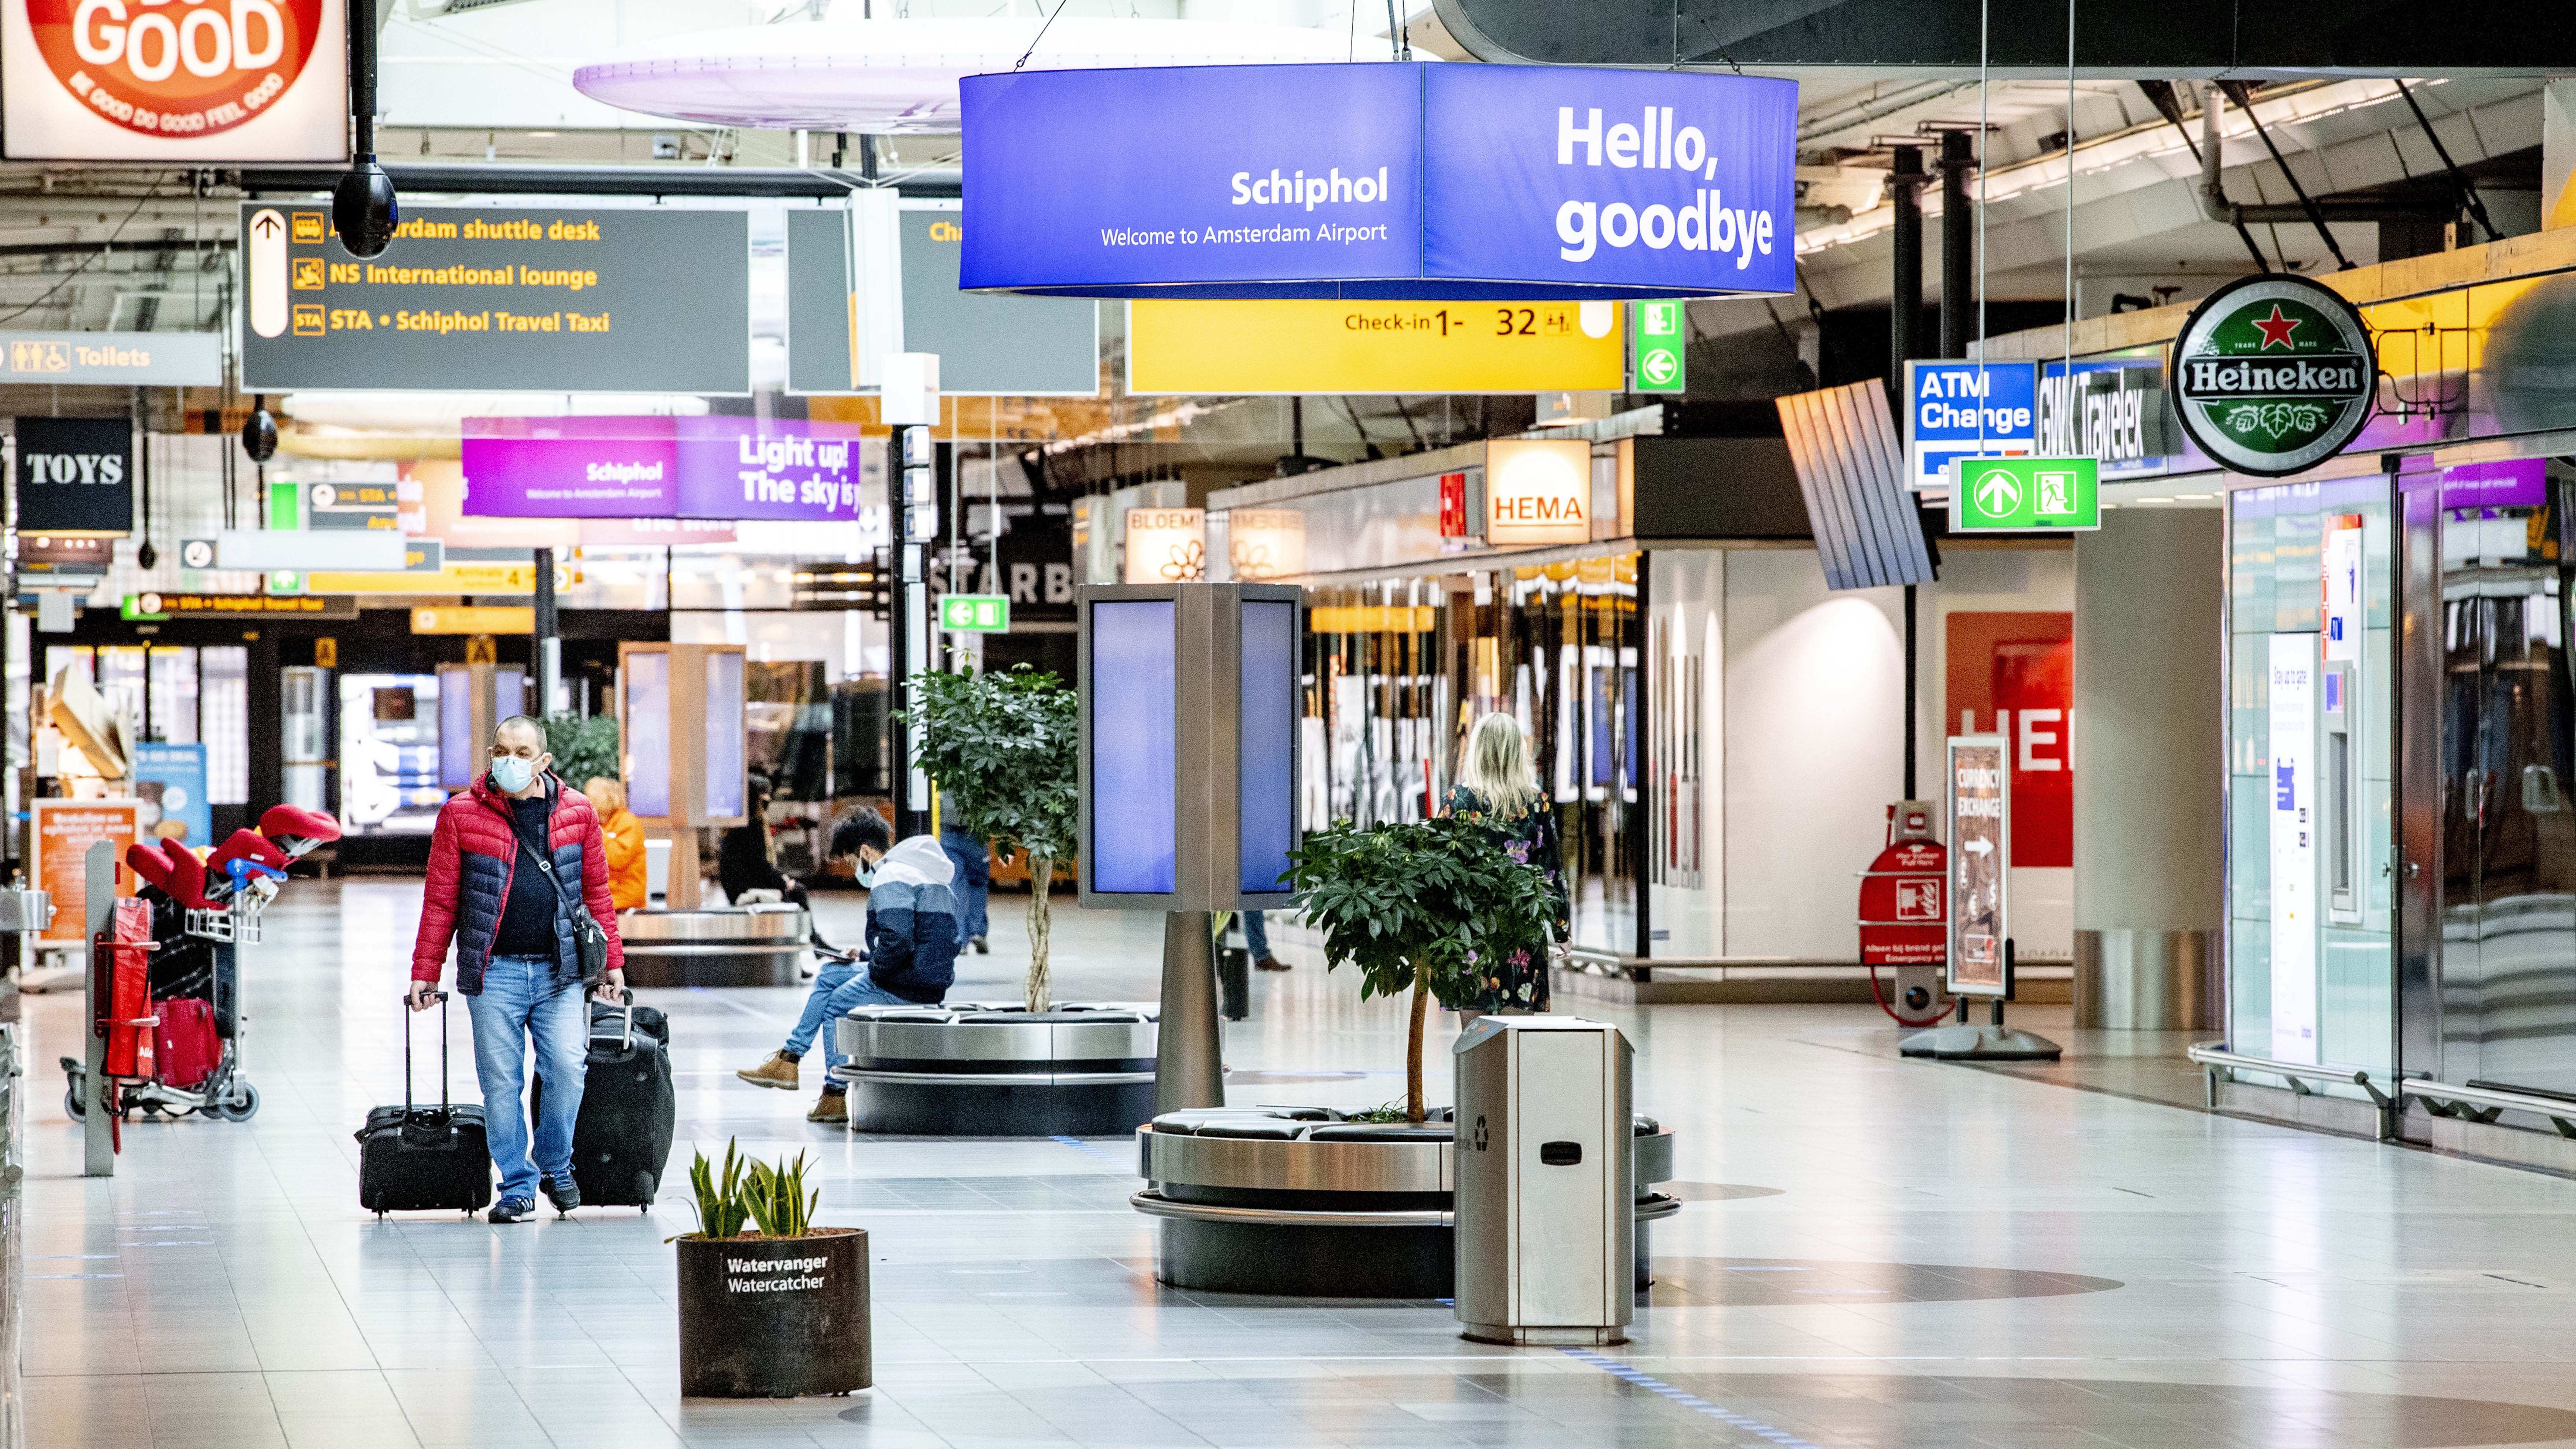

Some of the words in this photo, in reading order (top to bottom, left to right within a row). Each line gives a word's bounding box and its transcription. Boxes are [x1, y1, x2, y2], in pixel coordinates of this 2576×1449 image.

[73, 0, 284, 81] GOOD
[69, 71, 95, 97] BE
[90, 88, 133, 122] GOOD
[132, 110, 158, 130] DO
[160, 108, 206, 132] GOOD
[206, 103, 247, 127] FEEL
[244, 73, 284, 109] GOOD
[1557, 106, 1718, 180] Hello,
[1231, 166, 1387, 212] Schiphol
[464, 219, 542, 241] shuttle
[548, 220, 600, 242] desk
[929, 221, 962, 242] Ch
[1101, 228, 1175, 246] Welcome
[1179, 227, 1198, 244] to
[1202, 224, 1310, 244] Amsterdam
[1316, 224, 1387, 246] Airport
[1556, 189, 1773, 270] goodbye
[330, 264, 360, 284] NS
[367, 263, 513, 286] International
[520, 265, 598, 291] lounge
[330, 309, 373, 330] STA
[396, 310, 488, 334] Schiphol
[495, 311, 560, 331] Travel
[565, 312, 610, 332] Taxi
[1346, 315, 1430, 331] Check-in
[1497, 309, 1536, 336] 32
[75, 346, 151, 367] Toilets
[1920, 371, 1990, 398] ATM
[2192, 361, 2357, 392] Heineken
[1921, 402, 2030, 434] Change
[2079, 367, 2144, 462] Travelex
[739, 434, 814, 473] Light
[818, 438, 849, 475] up!
[26, 453, 123, 484] TOYS
[587, 461, 663, 484] Schiphol
[739, 469, 796, 504] The
[800, 472, 840, 513] sky
[1132, 513, 1201, 530] BLOEM
[1495, 497, 1583, 520] HEMA
[1958, 768, 2000, 788] CURRENCY
[1958, 798, 2000, 817] EXCHANGE
[727, 1256, 828, 1273] Watervanger
[728, 1275, 824, 1293] Watercatcher
